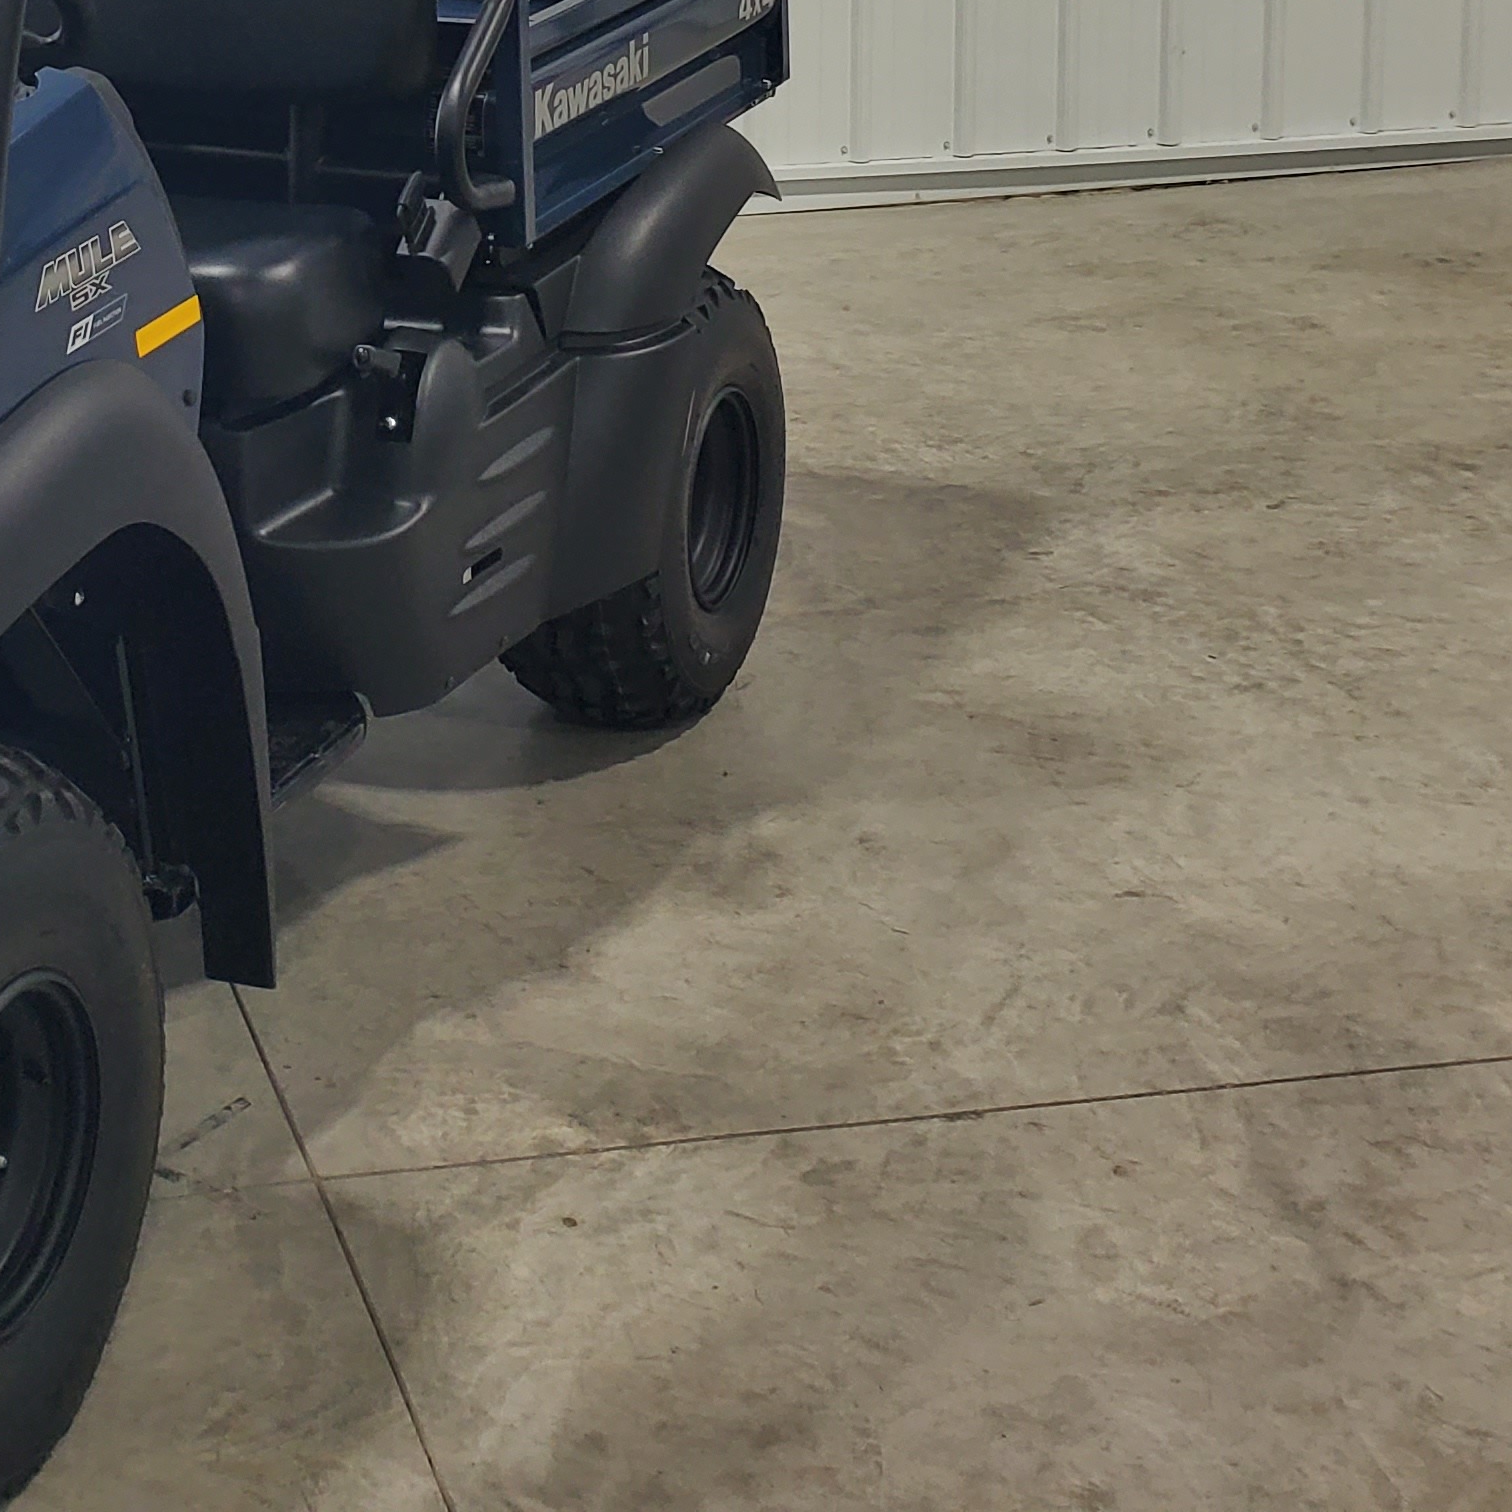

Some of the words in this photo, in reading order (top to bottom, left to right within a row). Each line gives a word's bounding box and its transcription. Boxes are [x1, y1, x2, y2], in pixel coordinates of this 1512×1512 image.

[534, 32, 649, 139] Kawasaki
[35, 220, 141, 312] MULE
[70, 270, 113, 311] SX
